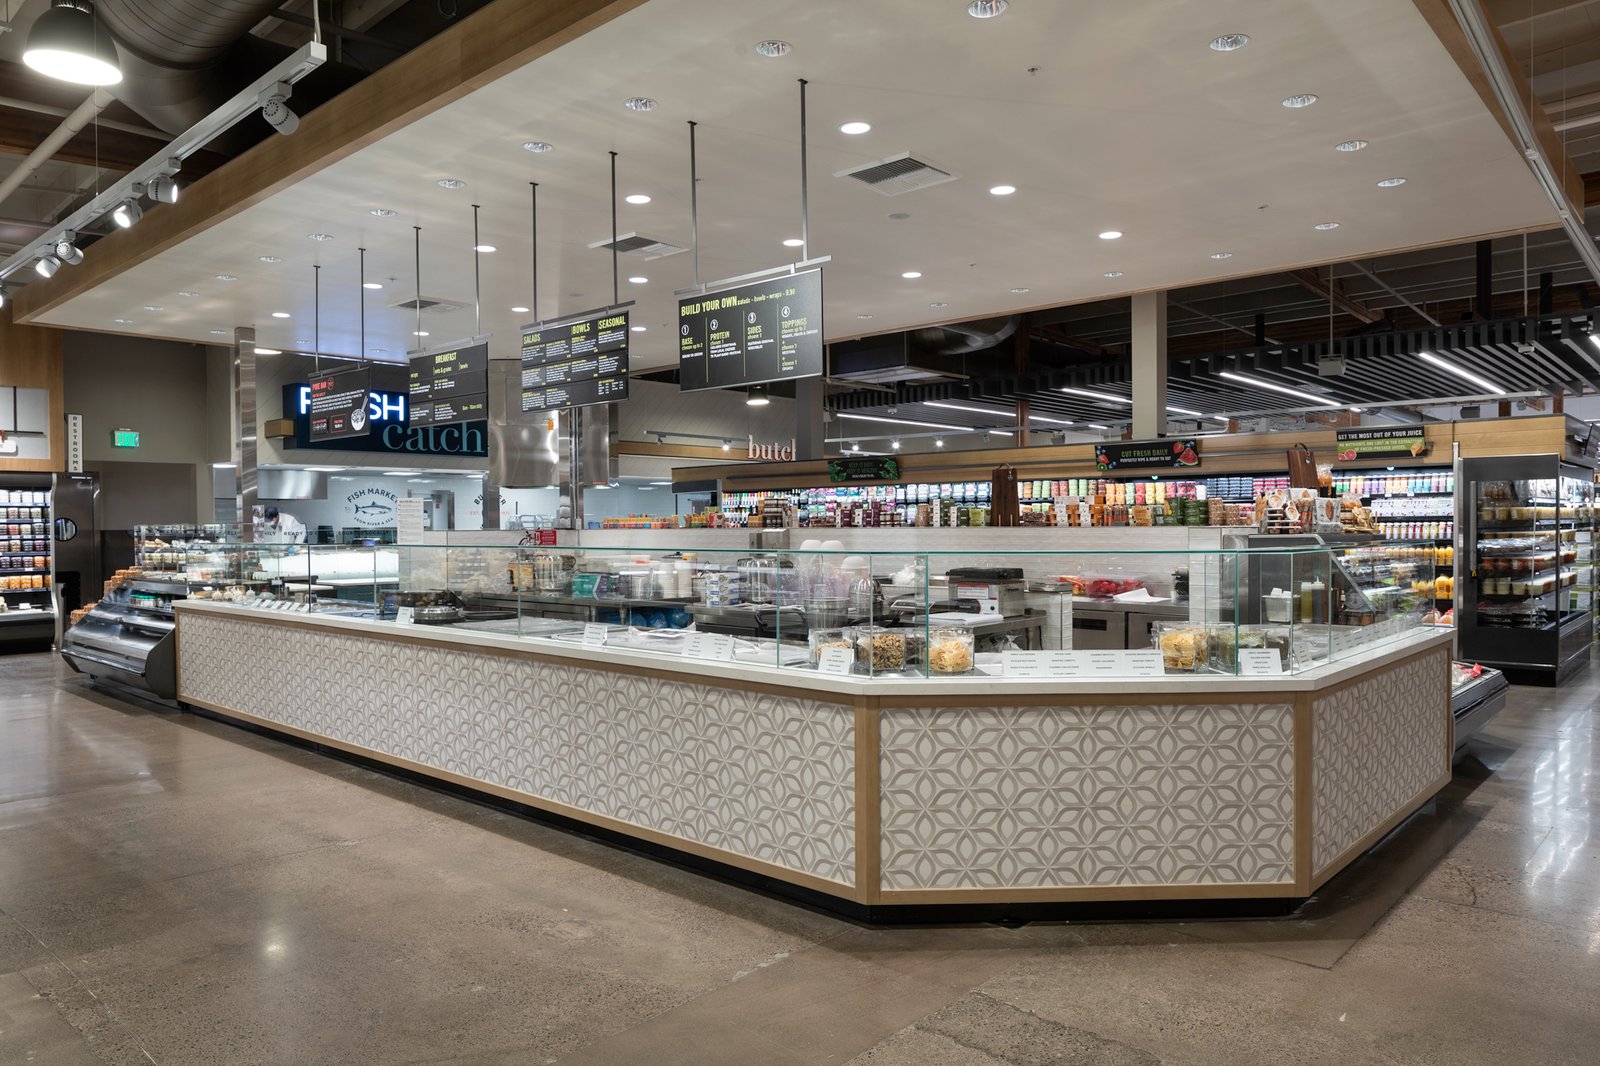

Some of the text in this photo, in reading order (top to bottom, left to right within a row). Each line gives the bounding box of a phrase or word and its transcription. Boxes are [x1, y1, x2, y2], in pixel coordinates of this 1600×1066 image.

[681, 303, 701, 317] BUILD
[702, 299, 720, 313] YOUR
[721, 296, 738, 308] OWN
[572, 323, 590, 334] BOWLS
[599, 316, 626, 330] SEASONAL
[782, 318, 808, 328] TOPPINGS
[710, 331, 730, 340] PROTEIN
[748, 326, 762, 334] SIDES
[524, 334, 541, 344] SALADS
[435, 352, 456, 364] BREAKFAST
[300, 386, 405, 422] FSH
[382, 422, 485, 452] catch
[347, 490, 366, 503] FISH
